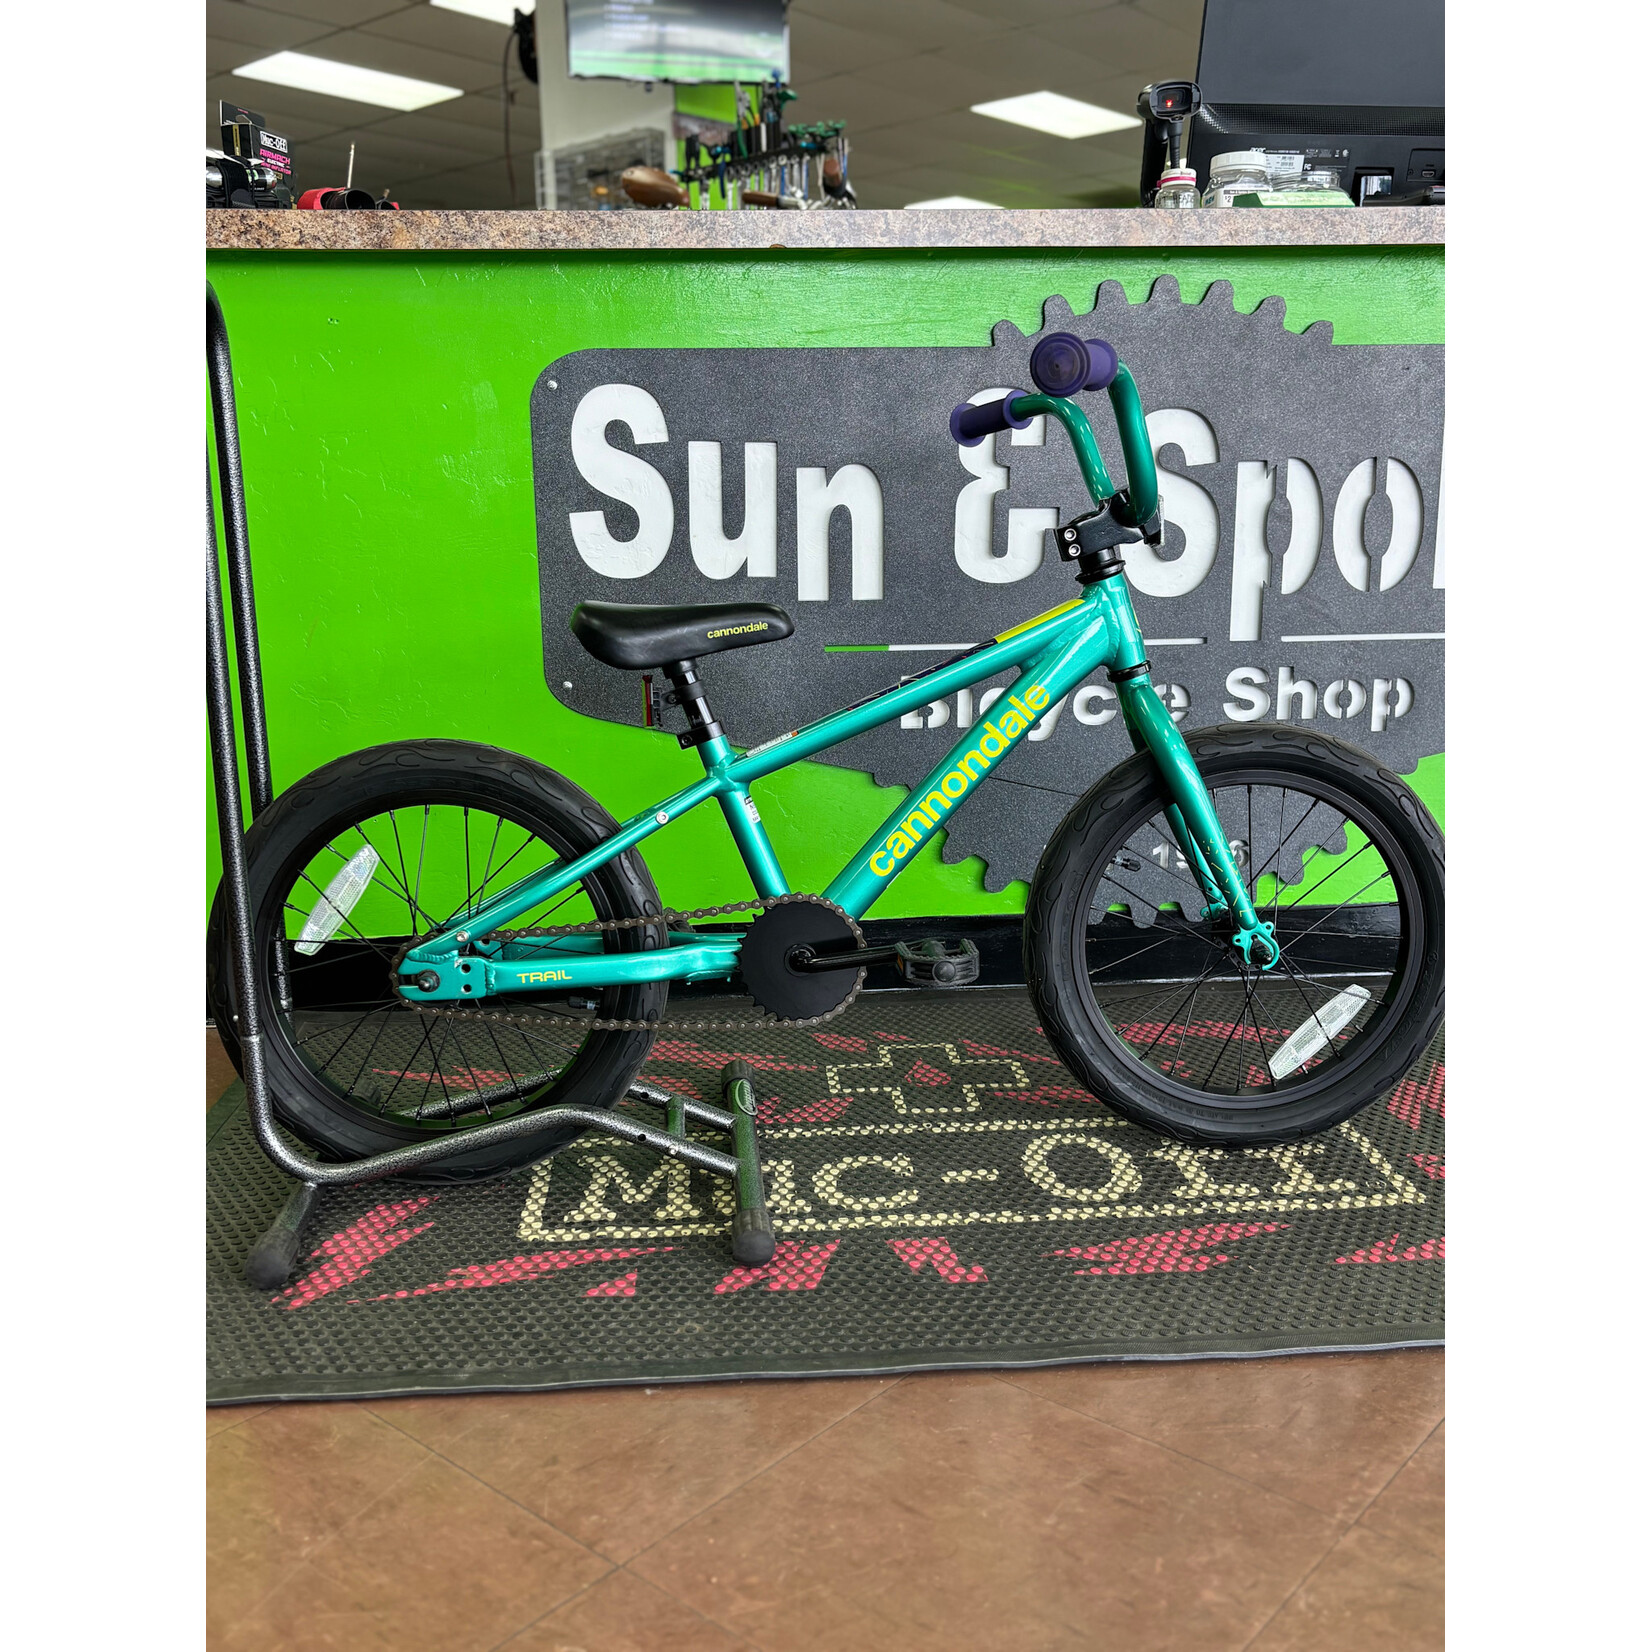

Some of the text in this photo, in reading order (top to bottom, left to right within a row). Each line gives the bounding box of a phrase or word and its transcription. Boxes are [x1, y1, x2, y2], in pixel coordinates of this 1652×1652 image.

[569, 383, 1445, 641] Sun & Spo
[706, 621, 769, 639] cannondale
[900, 665, 1415, 742] Biyce Shop
[868, 684, 1051, 878] cannondale
[516, 969, 573, 984] TRAIL
